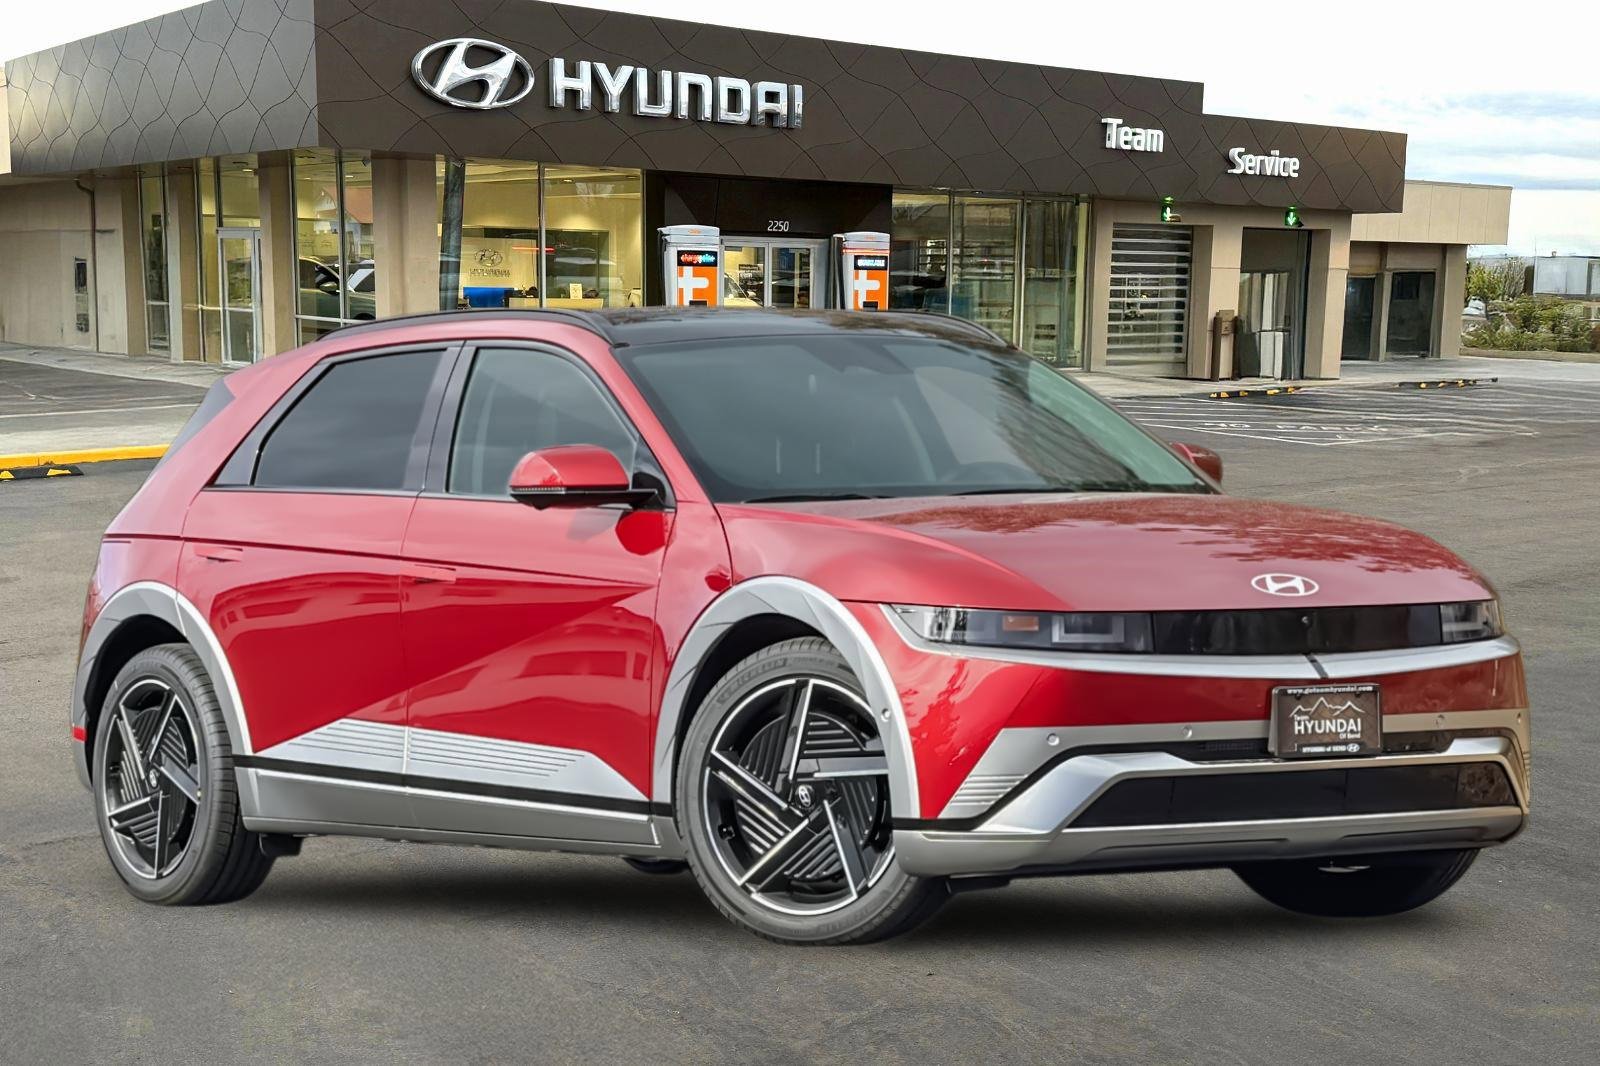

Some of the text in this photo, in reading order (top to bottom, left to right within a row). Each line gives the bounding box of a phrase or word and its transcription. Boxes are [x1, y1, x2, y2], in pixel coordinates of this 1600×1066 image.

[548, 57, 803, 129] HYUNDAI
[1102, 117, 1164, 152] Team
[1227, 147, 1300, 177] Service
[767, 220, 790, 232] 2250
[1294, 718, 1362, 735] HYUNDAI
